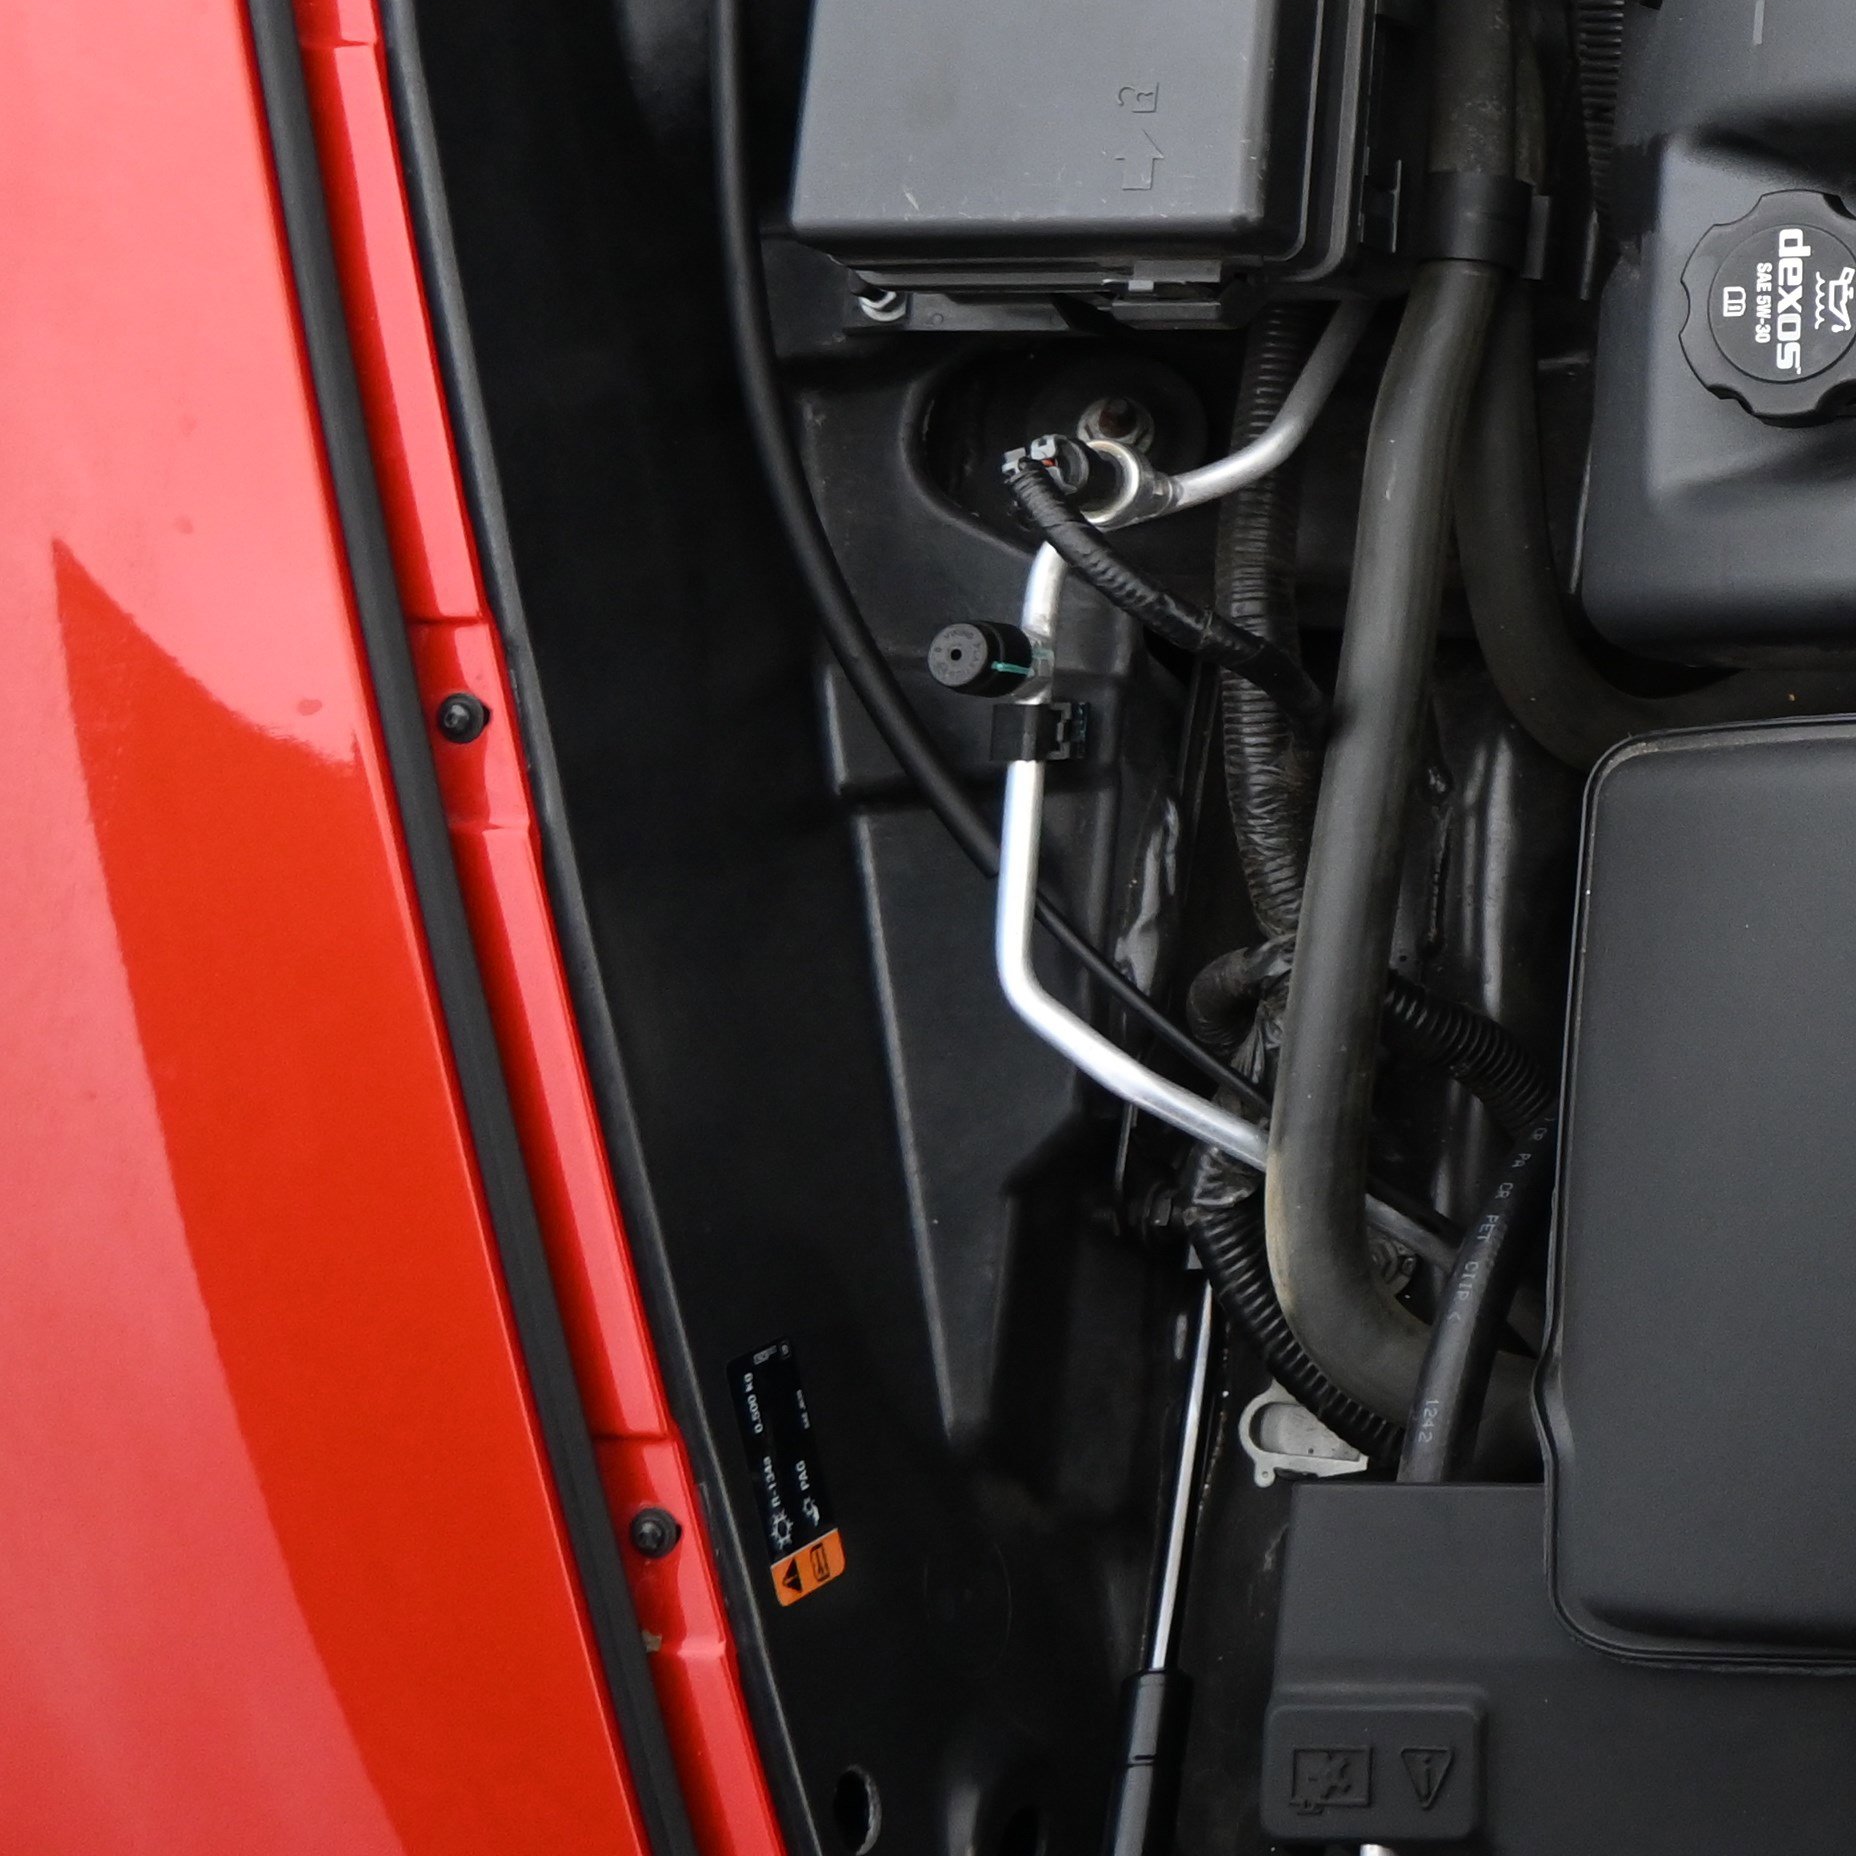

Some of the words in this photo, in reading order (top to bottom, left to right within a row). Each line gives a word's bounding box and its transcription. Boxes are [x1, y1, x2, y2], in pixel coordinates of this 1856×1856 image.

[1756, 261, 1773, 295] SAE
[1754, 295, 1773, 344] 5W-30
[1776, 228, 1811, 371] dexos
[1476, 1213, 1500, 1243] PET
[747, 1393, 764, 1435] 0.500
[1418, 1397, 1440, 1444] 1242
[795, 1458, 811, 1492] PAG
